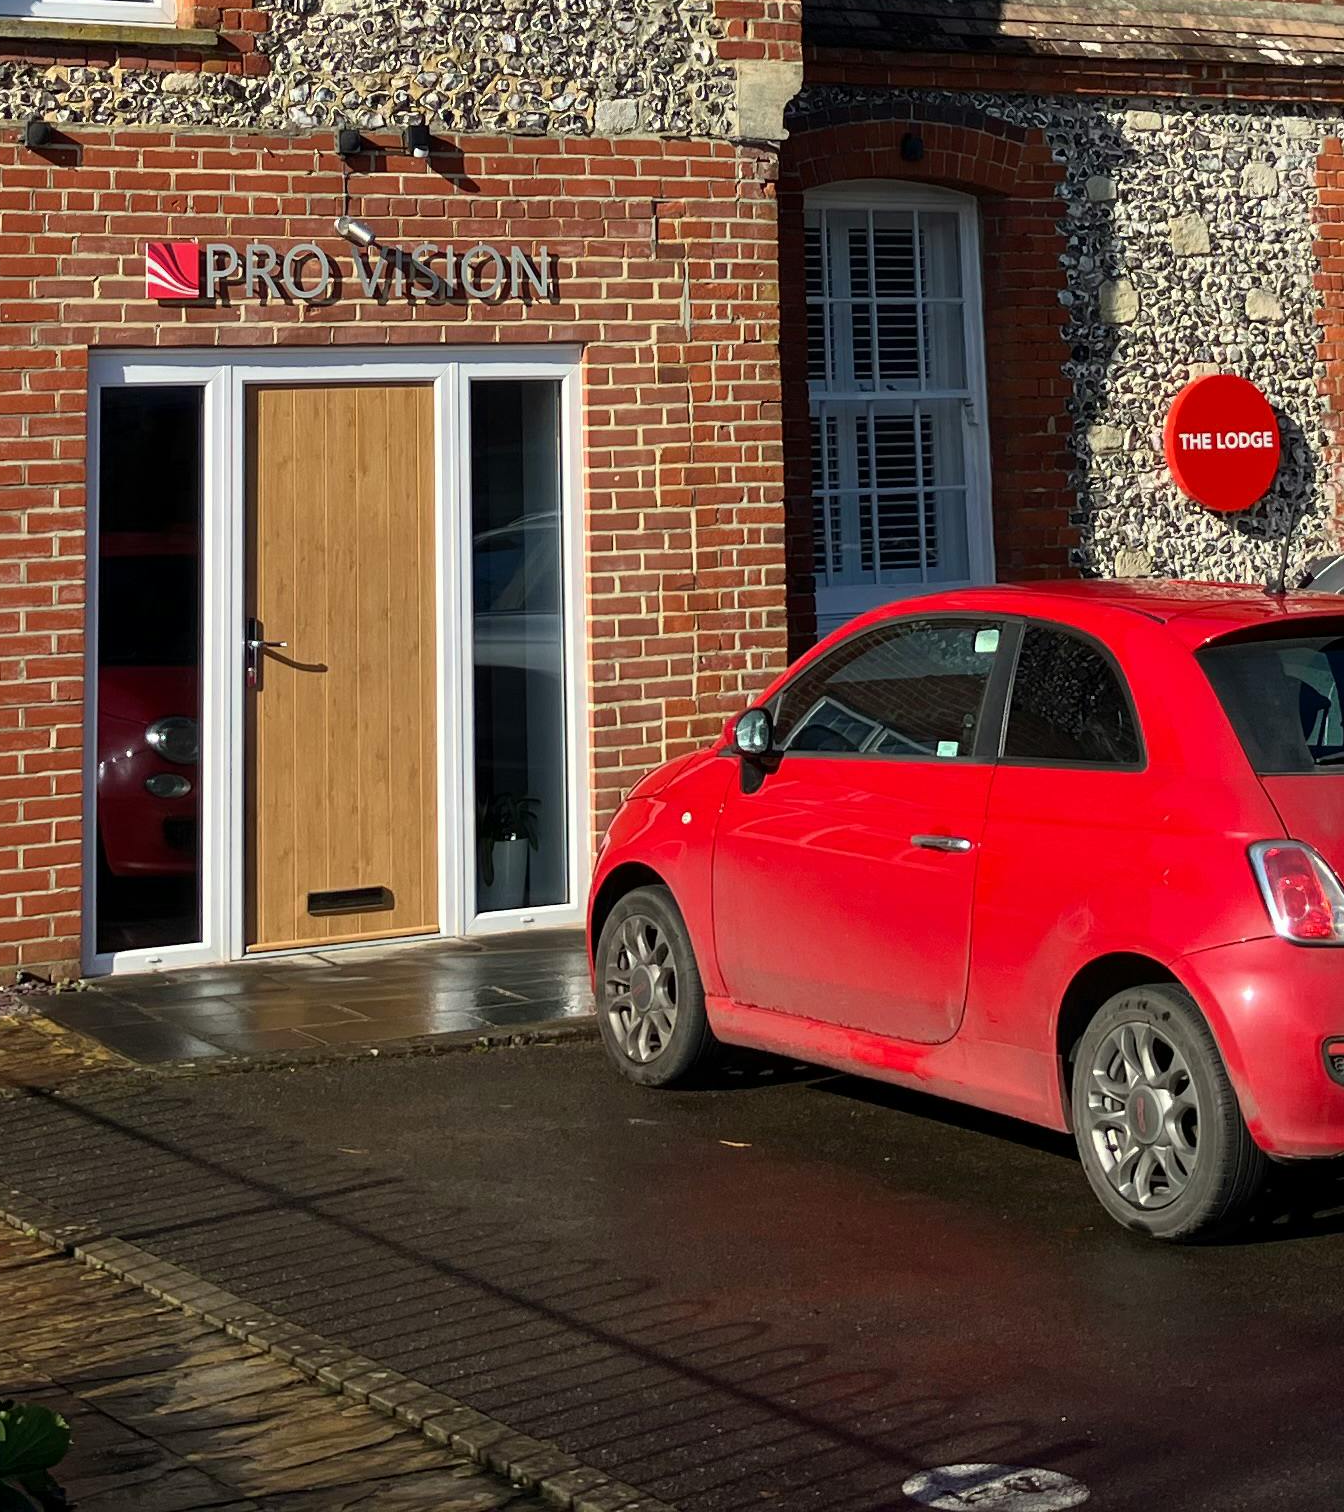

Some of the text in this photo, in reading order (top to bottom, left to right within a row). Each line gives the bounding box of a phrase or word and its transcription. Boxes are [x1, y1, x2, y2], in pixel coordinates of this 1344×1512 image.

[206, 244, 549, 298] PRO VISION
[1179, 432, 1273, 450] THE LODGE
